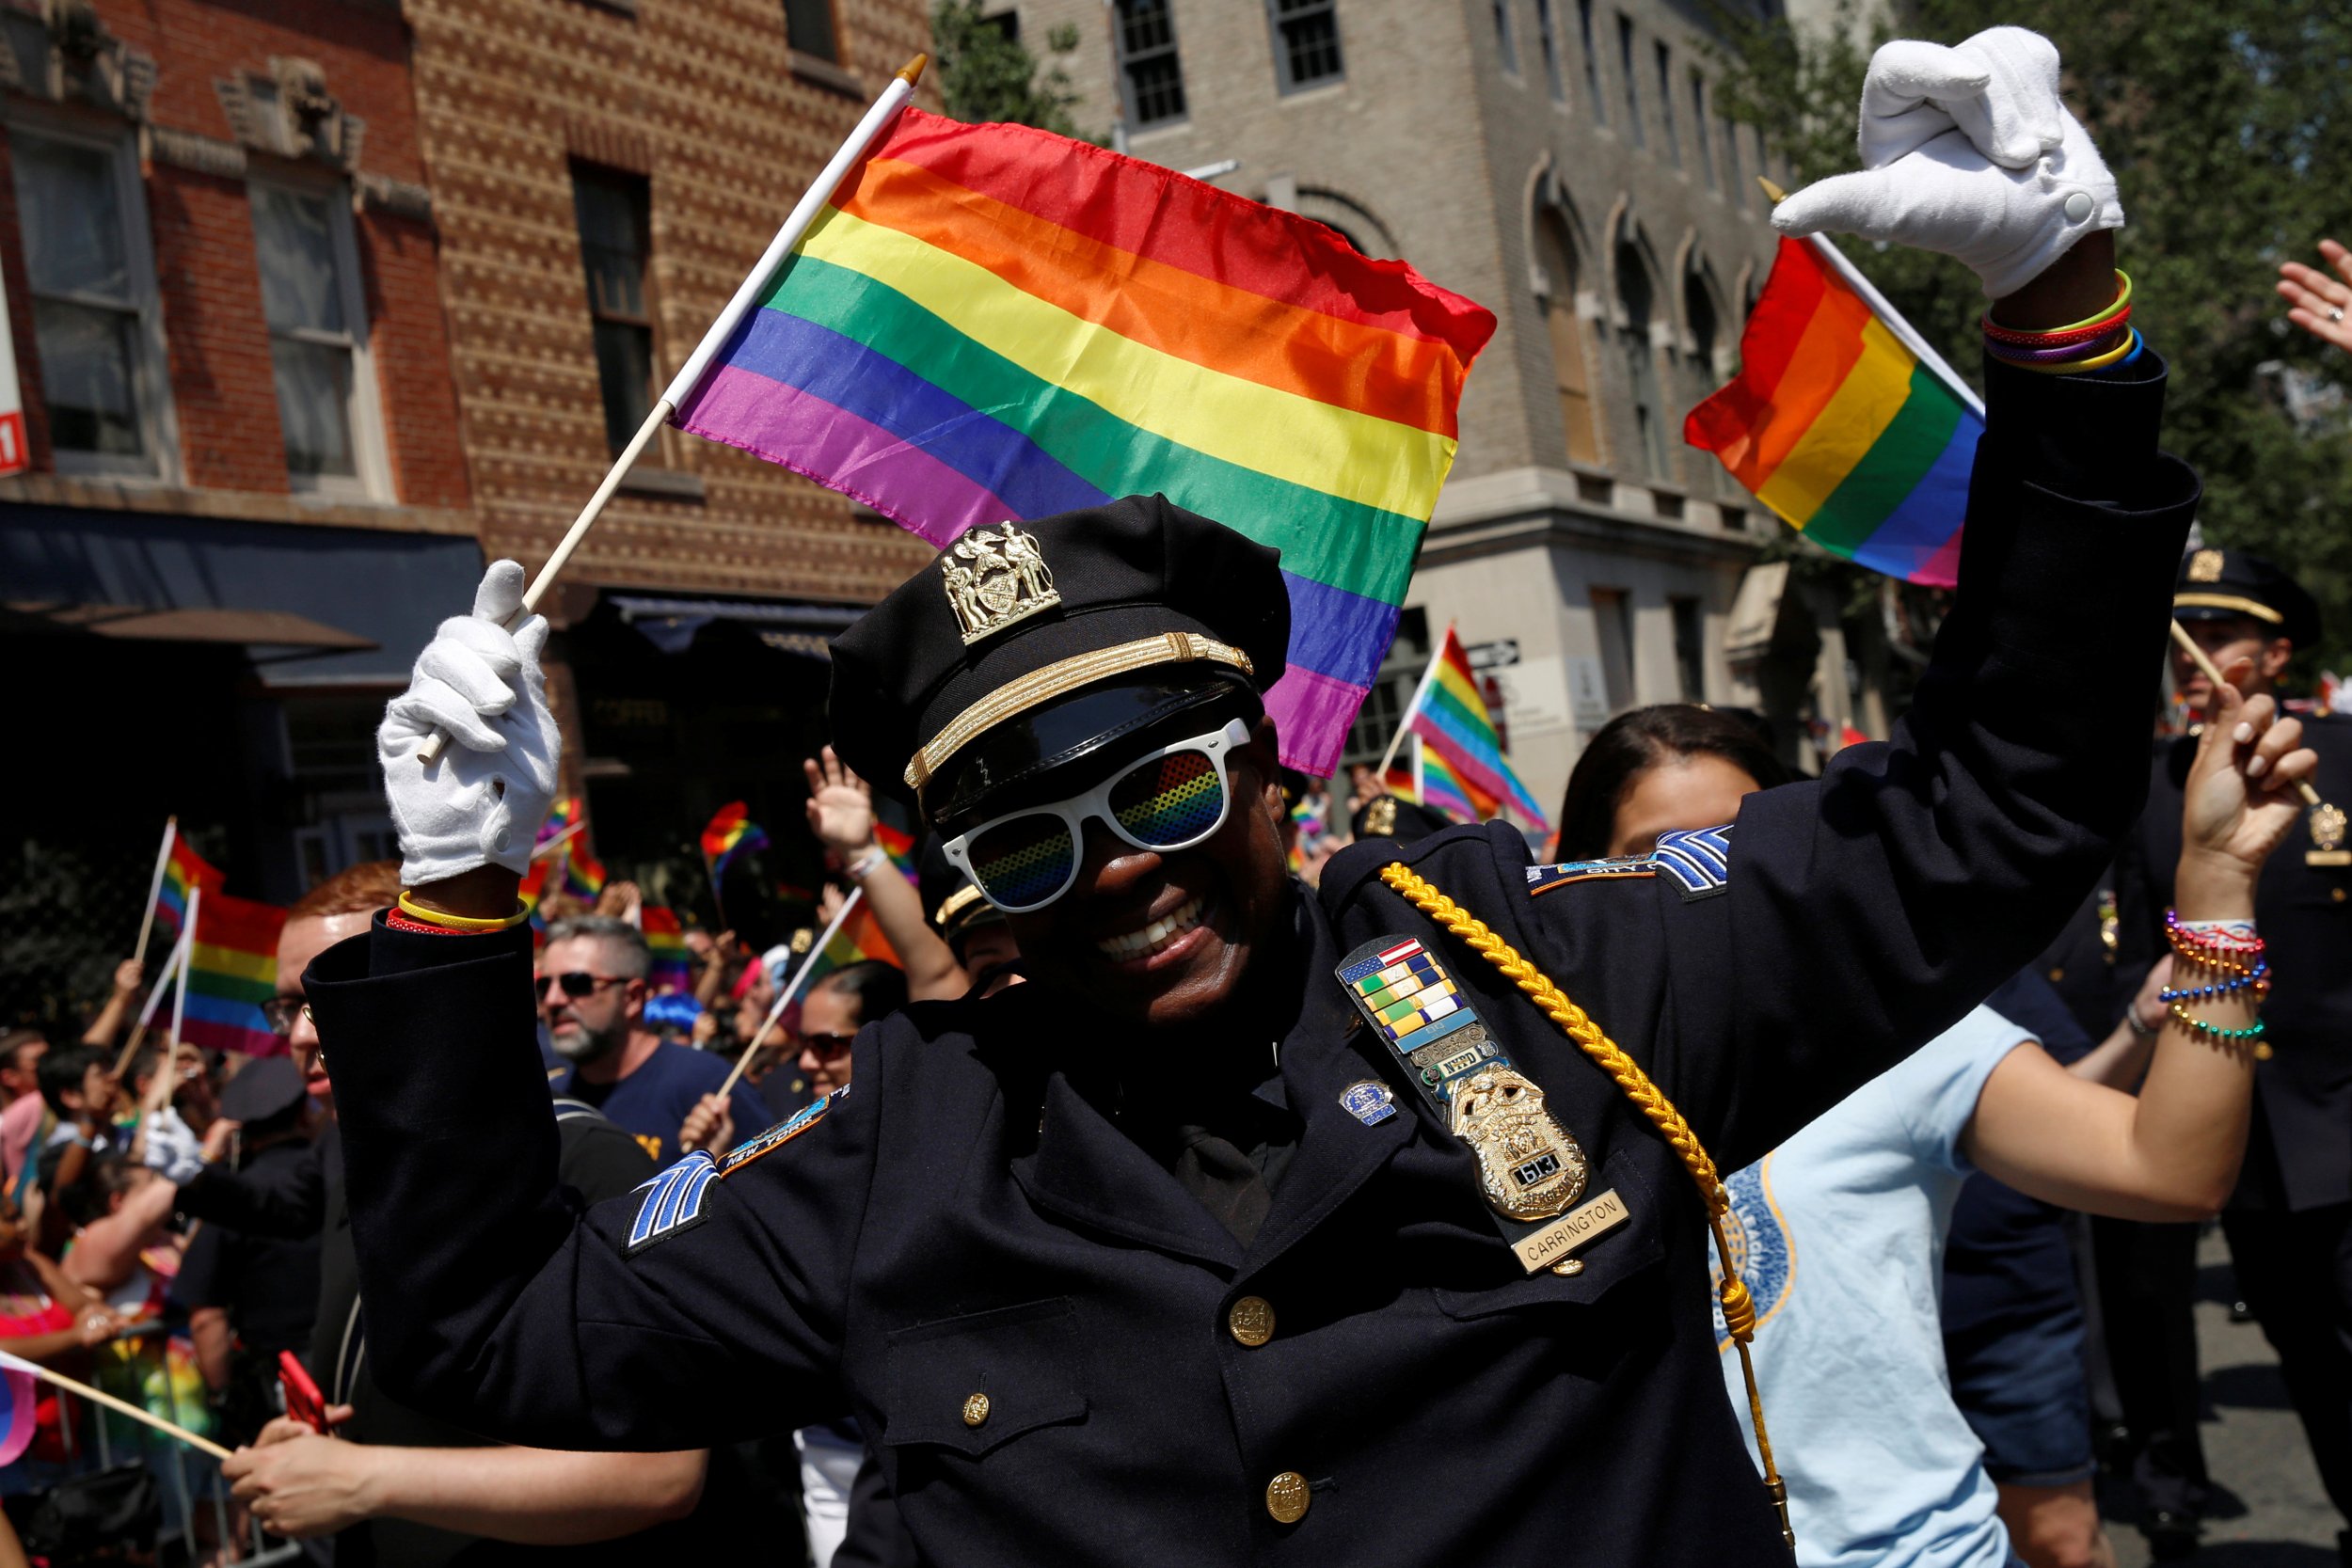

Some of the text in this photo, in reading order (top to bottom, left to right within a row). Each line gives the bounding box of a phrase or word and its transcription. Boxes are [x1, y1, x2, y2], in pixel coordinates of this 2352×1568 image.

[1586, 865, 1636, 874] CITY
[1443, 1052, 1477, 1074] NYPD
[726, 1116, 813, 1167] NEW YORK
[1519, 1155, 1557, 1185] 613
[1523, 1170, 1577, 1205] SERGEANT
[1527, 1199, 1617, 1261] CARRINGTON
[1736, 1204, 1762, 1280] LEAGUE
